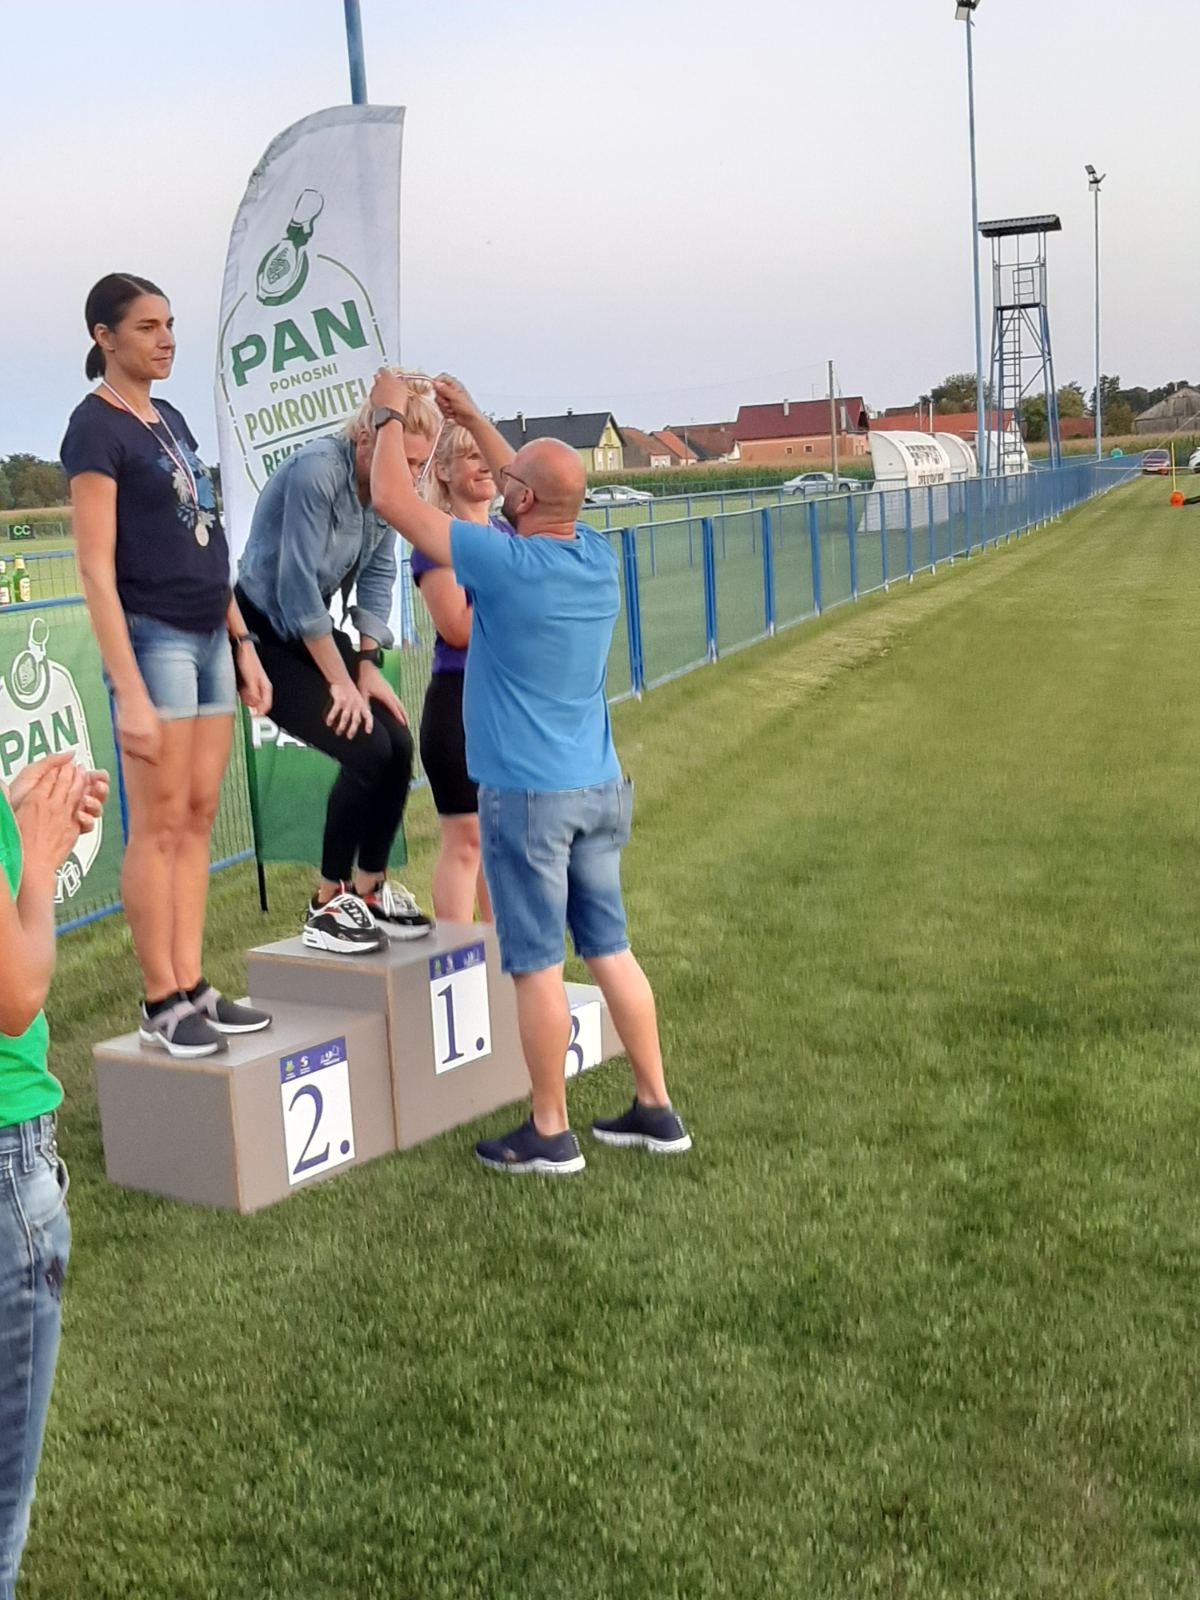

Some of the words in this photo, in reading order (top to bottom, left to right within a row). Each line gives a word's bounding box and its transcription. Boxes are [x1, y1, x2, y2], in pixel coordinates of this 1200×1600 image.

[231, 300, 369, 387] PAN
[270, 363, 338, 394] PONOSNI
[0, 705, 79, 776] PAN
[437, 984, 485, 1064] 1.
[288, 1084, 350, 1175] 2.
